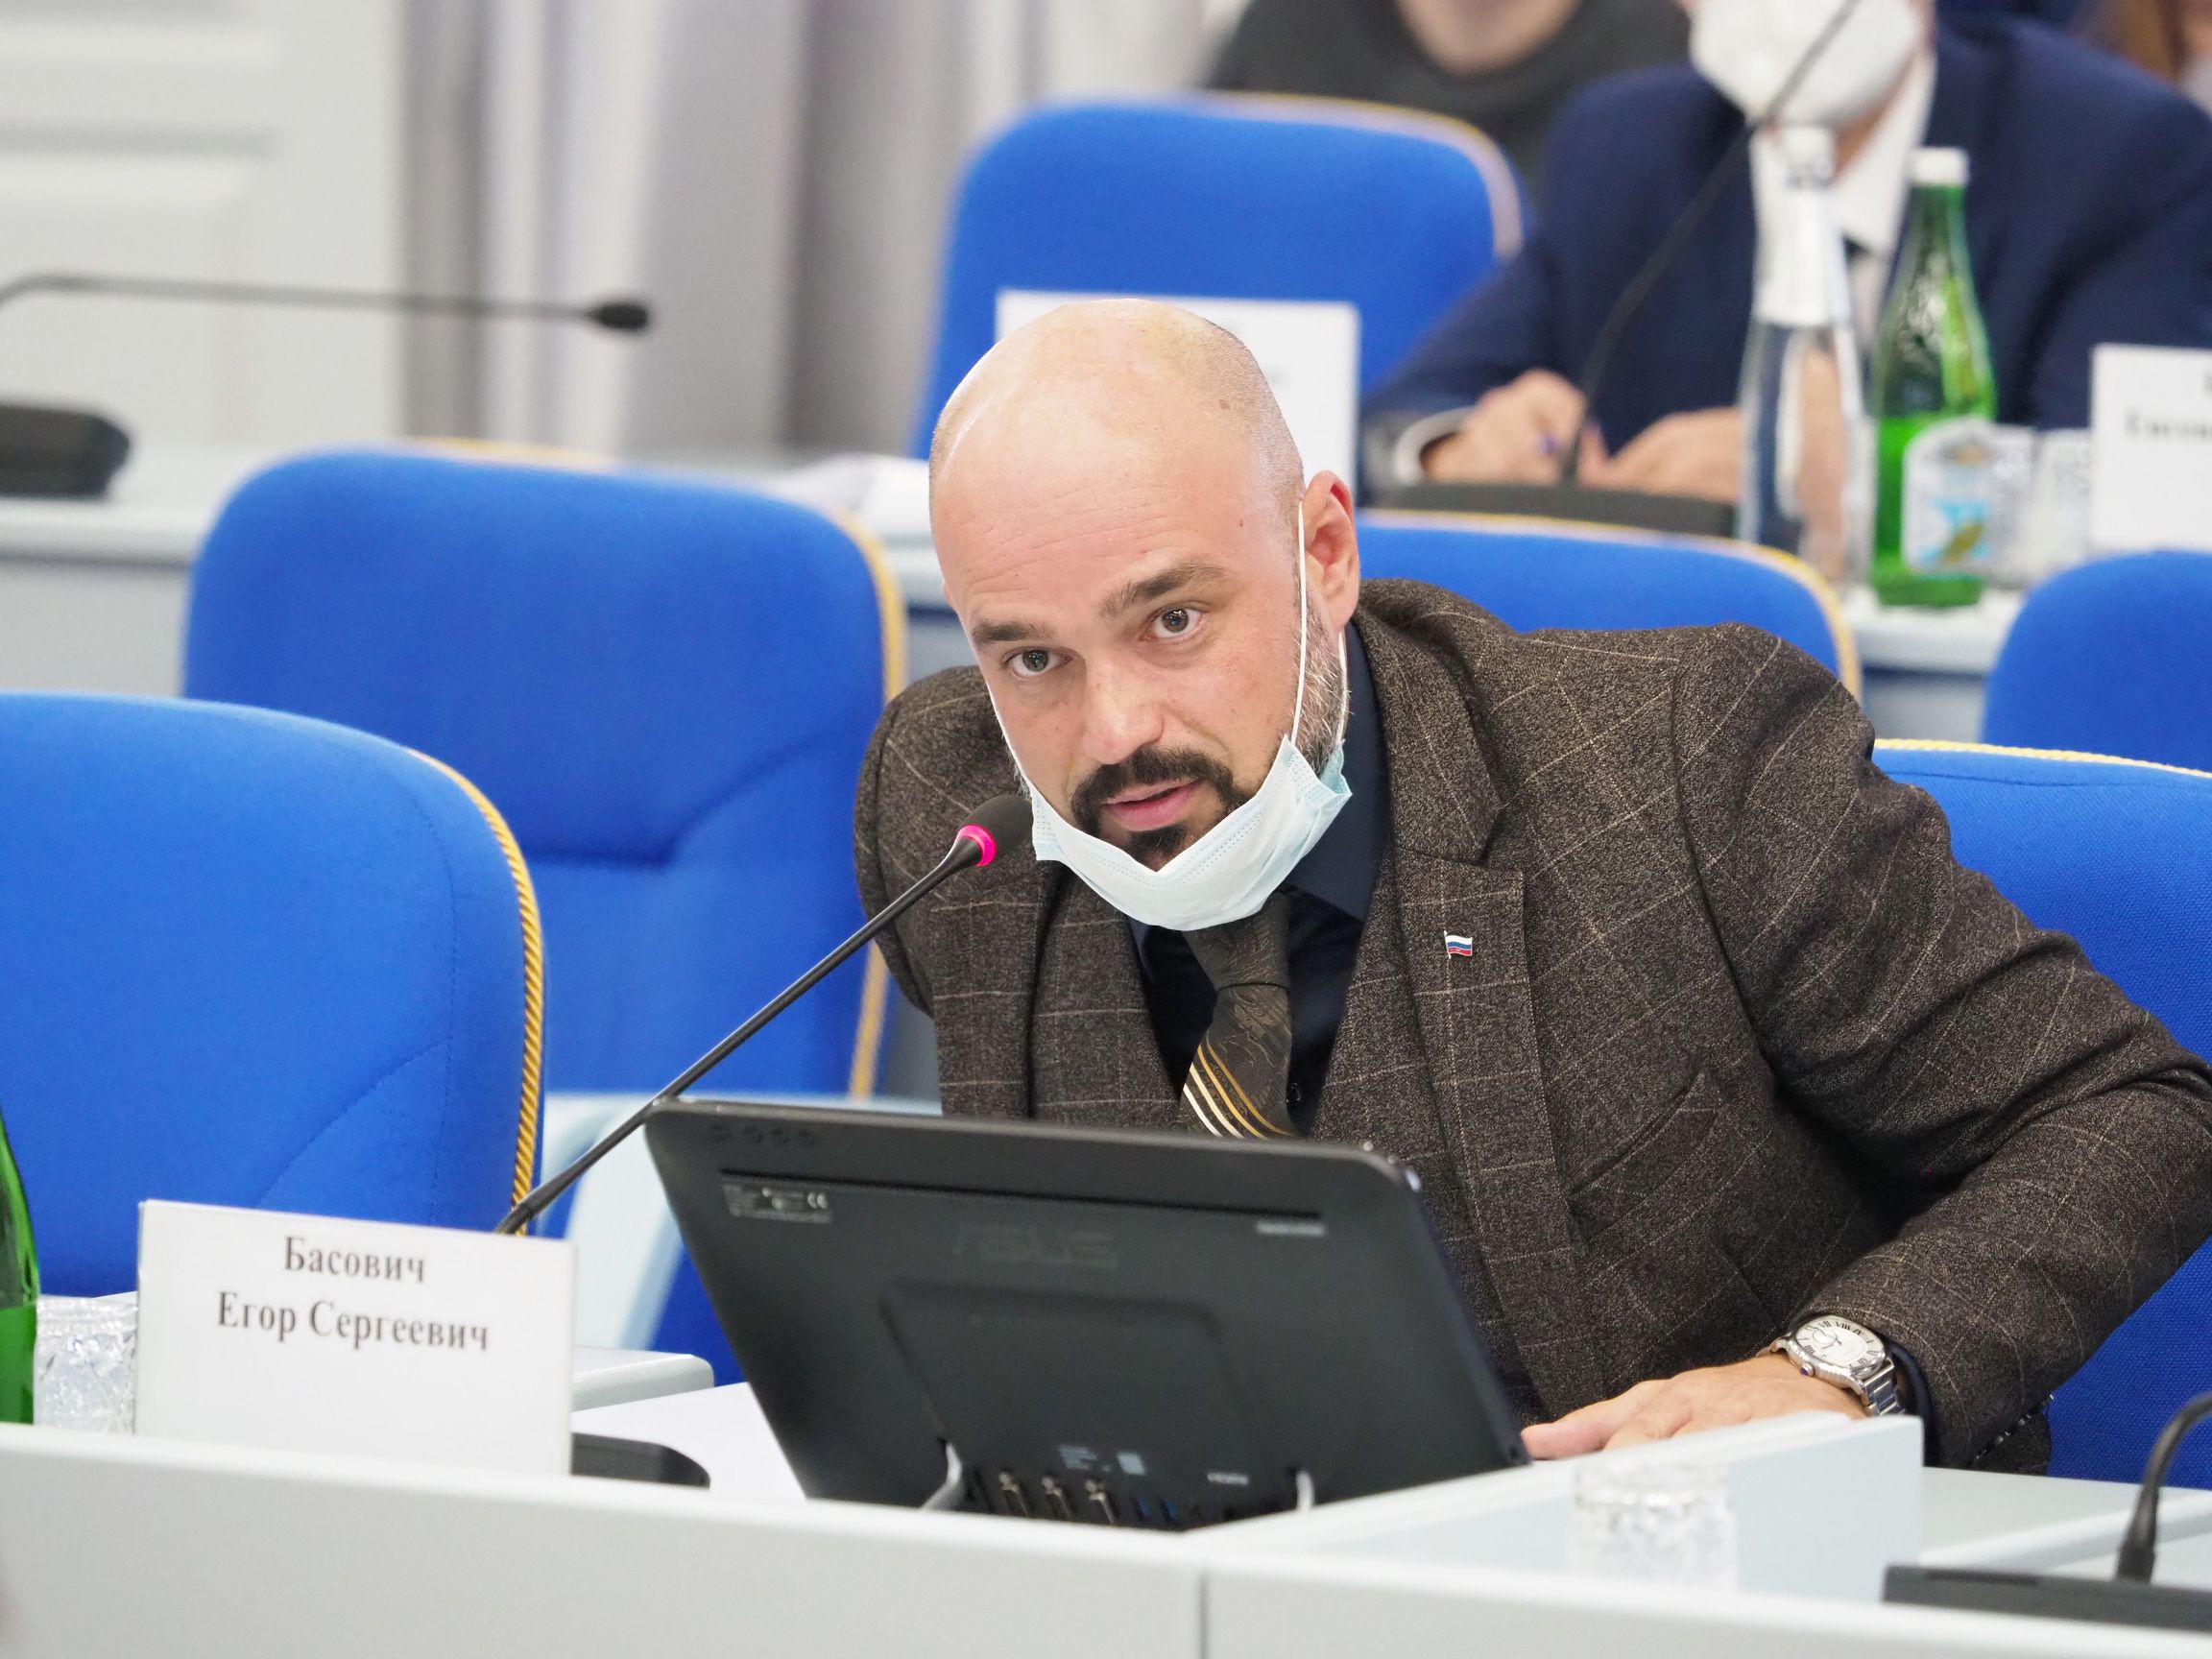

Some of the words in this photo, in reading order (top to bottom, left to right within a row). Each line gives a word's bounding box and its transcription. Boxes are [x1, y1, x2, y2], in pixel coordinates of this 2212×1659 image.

[284, 1236, 425, 1284] Басович
[217, 1291, 297, 1343] Егор
[309, 1299, 490, 1352] Сергеевич
